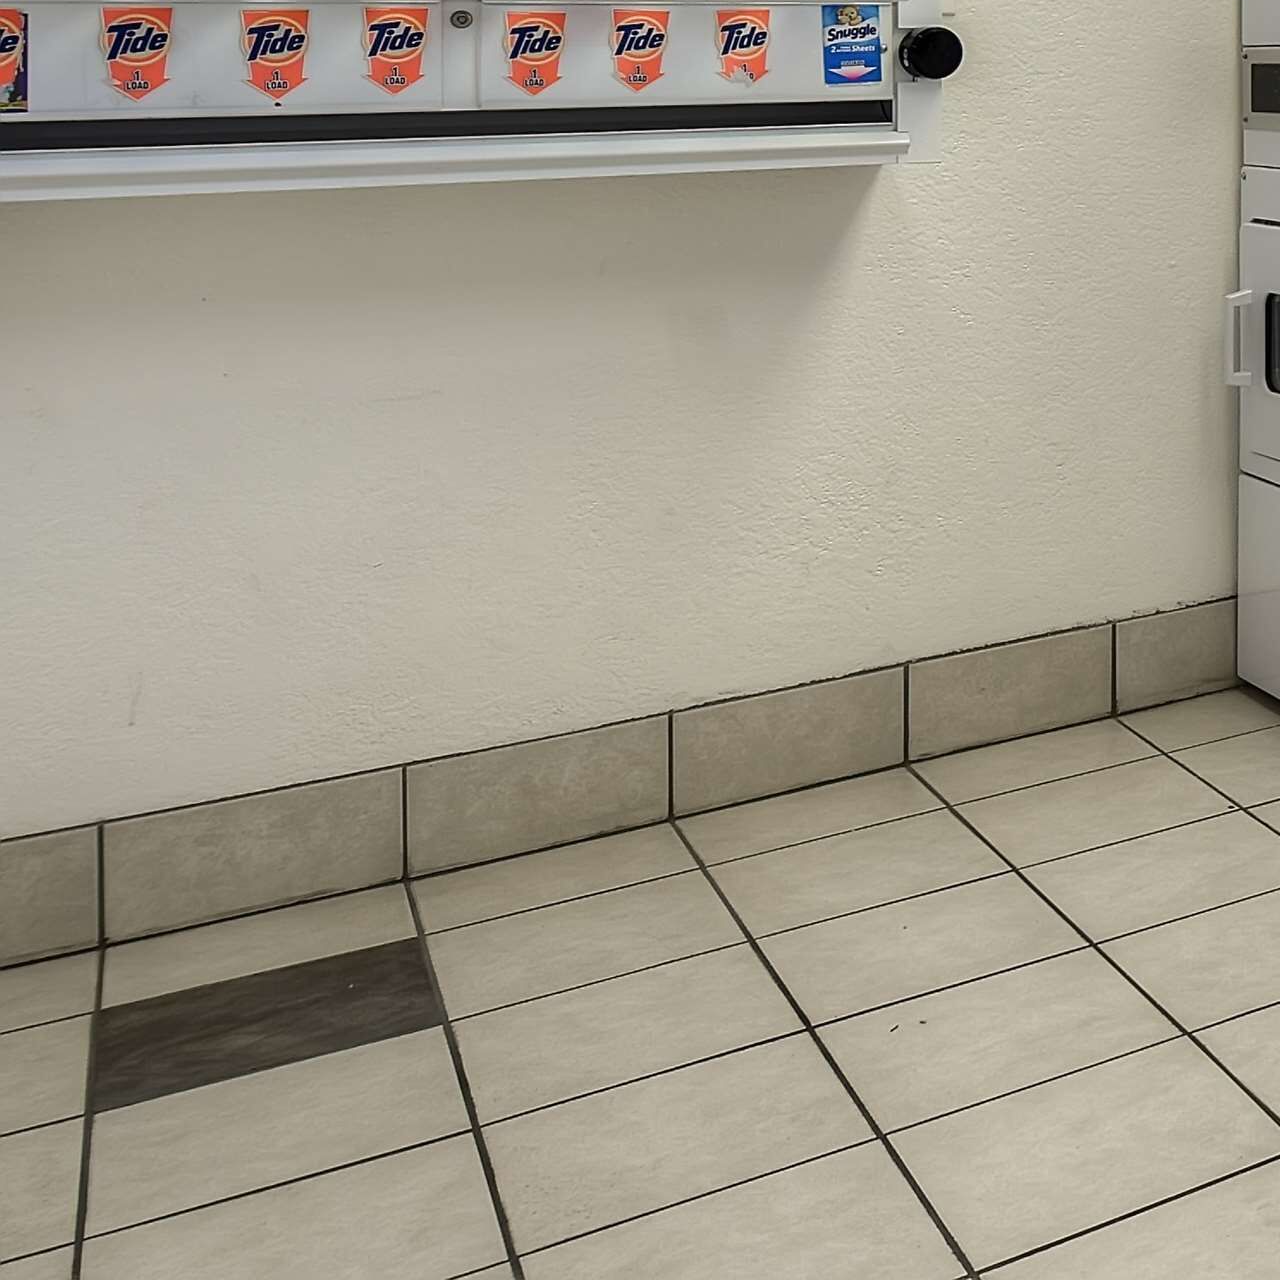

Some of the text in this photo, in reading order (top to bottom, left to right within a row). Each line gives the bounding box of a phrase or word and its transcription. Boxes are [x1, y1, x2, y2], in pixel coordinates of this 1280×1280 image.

[827, 23, 877, 42] Snuggle
[106, 22, 168, 61] Tide
[247, 23, 306, 62] Tide
[368, 21, 424, 58] Tide
[509, 25, 562, 59] Tide
[614, 23, 665, 56] Tide
[720, 22, 768, 56] Tide
[392, 67, 398, 77] 1
[531, 69, 537, 78] 1
[635, 65, 641, 74] 1
[742, 64, 747, 73] 1
[133, 71, 140, 81] 1
[273, 71, 280, 81] 1
[384, 77, 406, 85] LOAD
[628, 75, 647, 83] LOAD
[126, 81, 149, 90] LOAD
[266, 81, 288, 89] LOAD
[524, 78, 545, 87] LOAD
